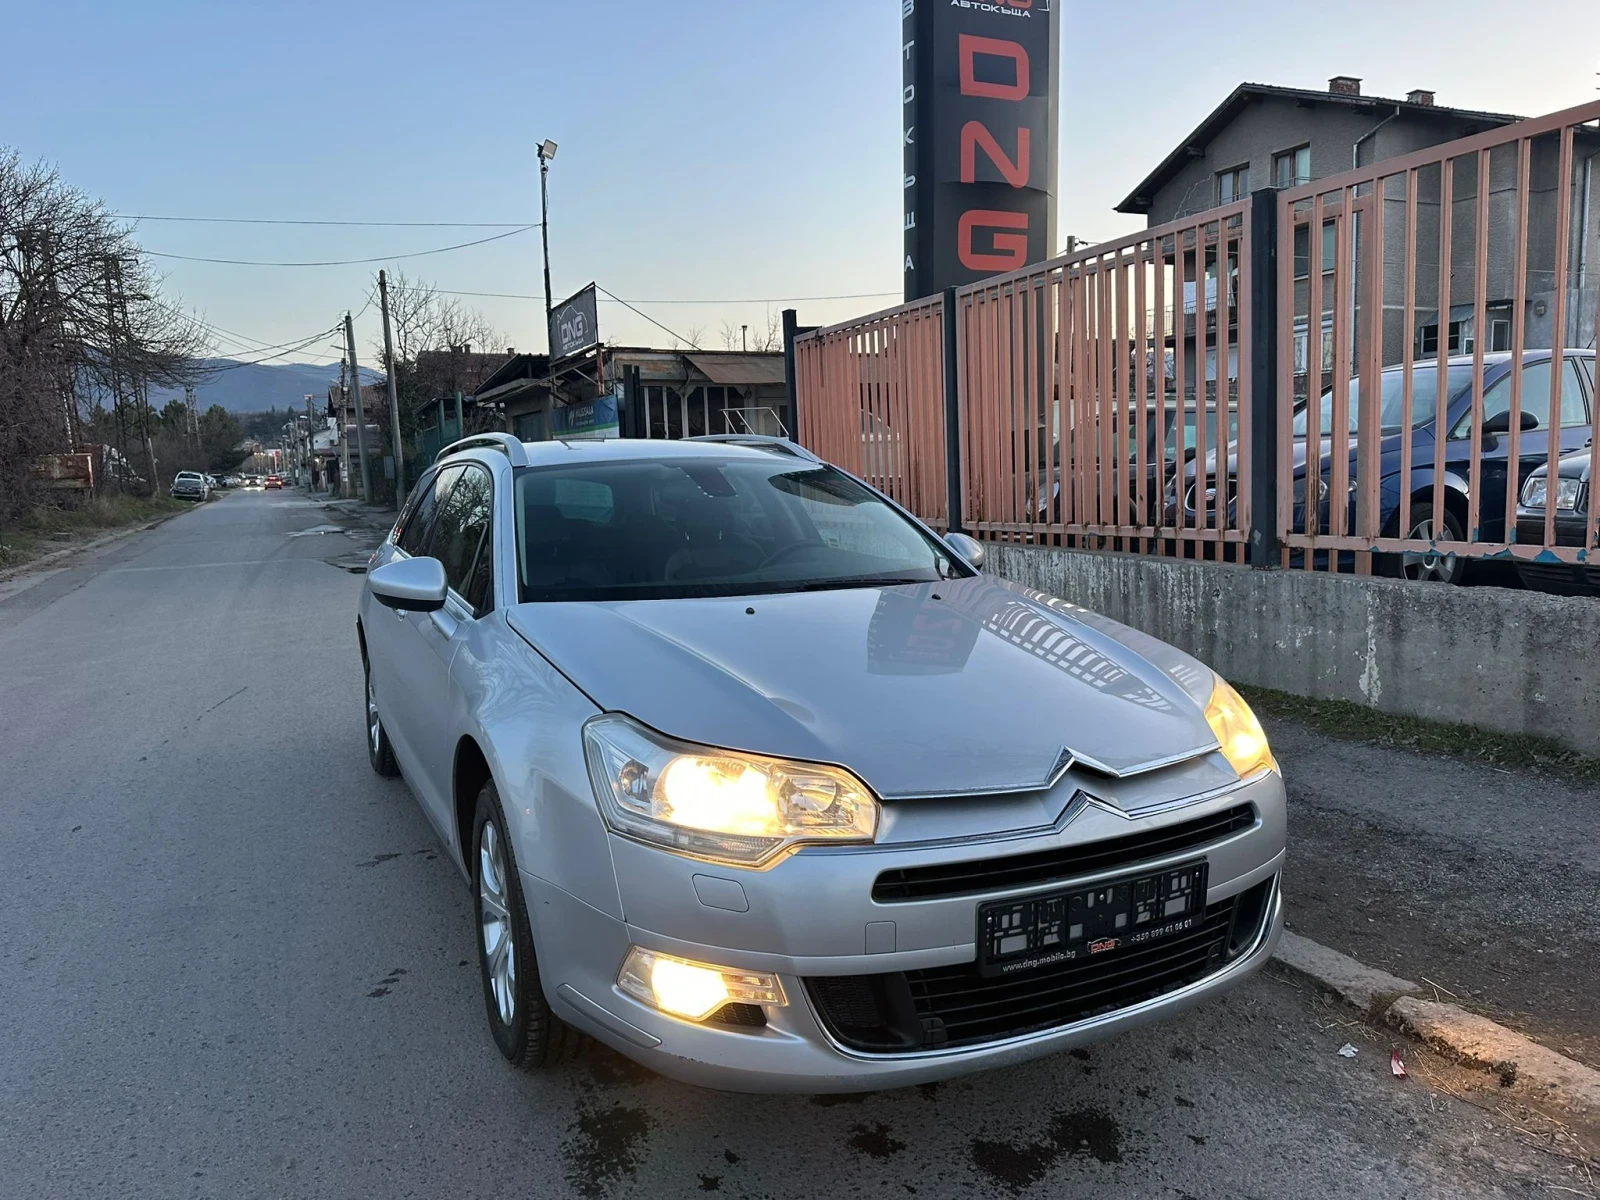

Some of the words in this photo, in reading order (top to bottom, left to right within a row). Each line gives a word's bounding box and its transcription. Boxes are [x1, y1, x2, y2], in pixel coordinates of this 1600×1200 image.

[958, 33, 1030, 271] DNG
[561, 315, 583, 344] DNG
[1131, 931, 1150, 943] +359
[1150, 927, 1164, 938] 899
[1165, 924, 1173, 934] 41
[1184, 918, 1192, 928] 01
[1002, 950, 1076, 972] www.dng.mobile.bg
